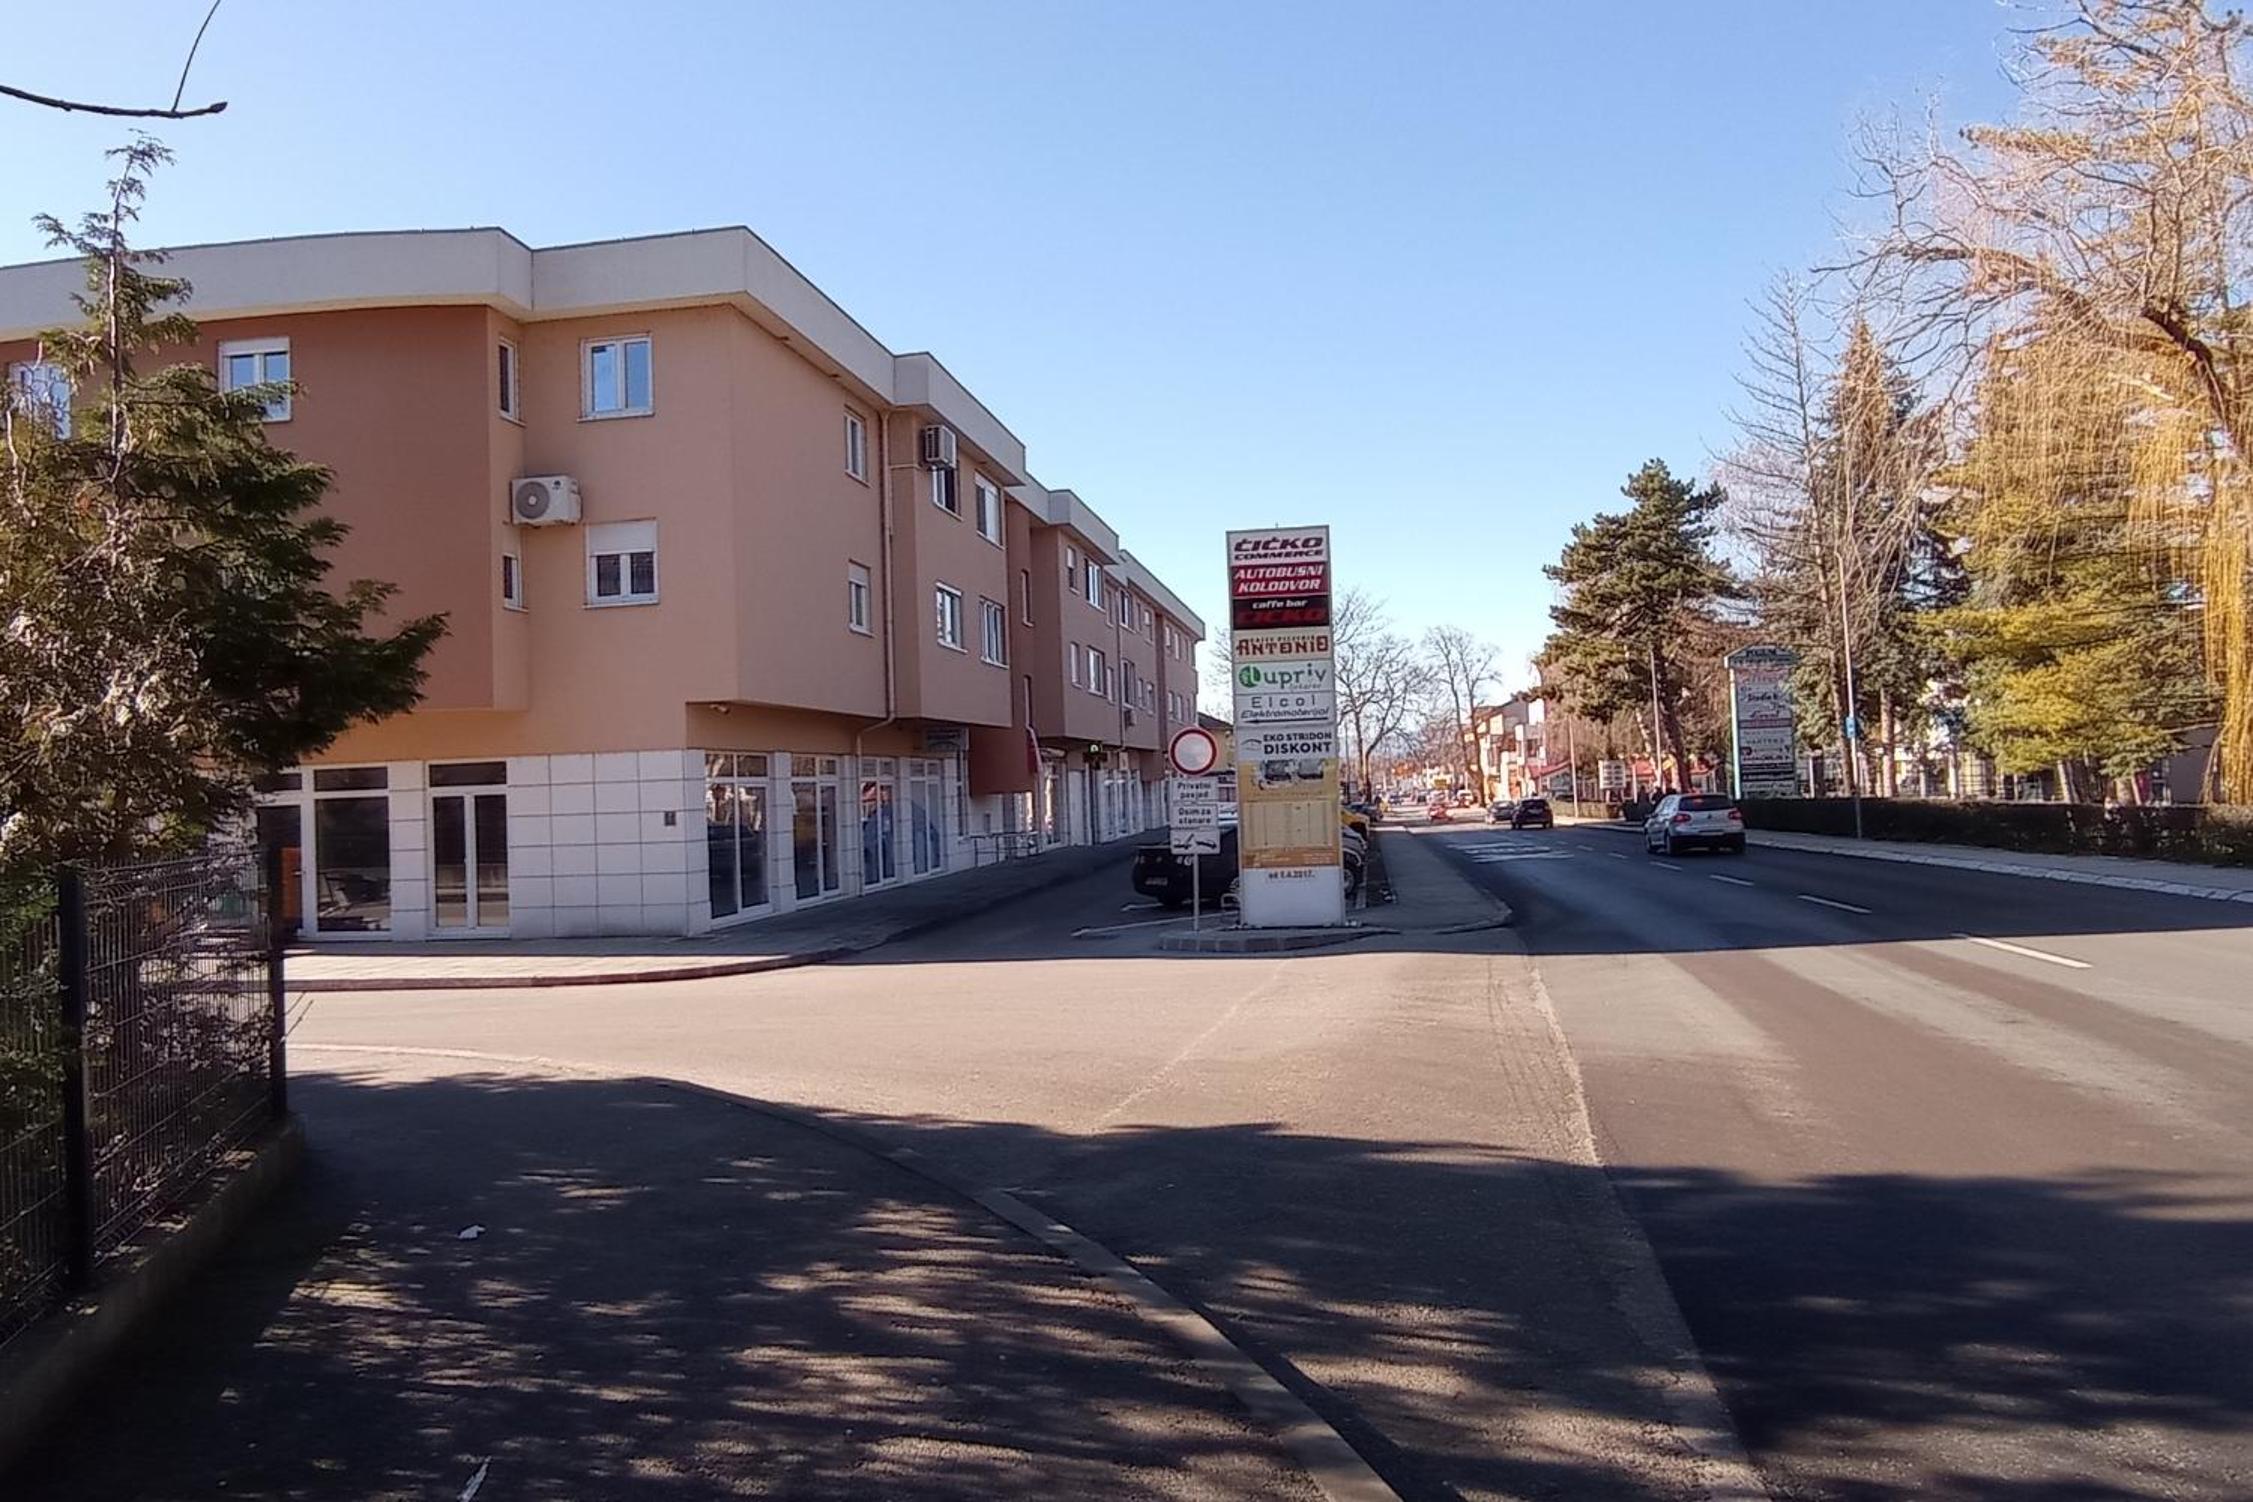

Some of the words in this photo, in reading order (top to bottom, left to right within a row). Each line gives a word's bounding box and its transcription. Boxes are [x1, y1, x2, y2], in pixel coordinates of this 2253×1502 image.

[1235, 549, 1323, 561] COMMERCE
[1234, 565, 1324, 579] AUTOBUSNI
[1238, 579, 1321, 593] KOLODVOR
[1252, 600, 1284, 609] caffe
[1286, 599, 1308, 608] bar
[1236, 635, 1328, 655] ANTONIO
[1251, 695, 1316, 708] Elcol
[1263, 742, 1332, 755] DISKONT
